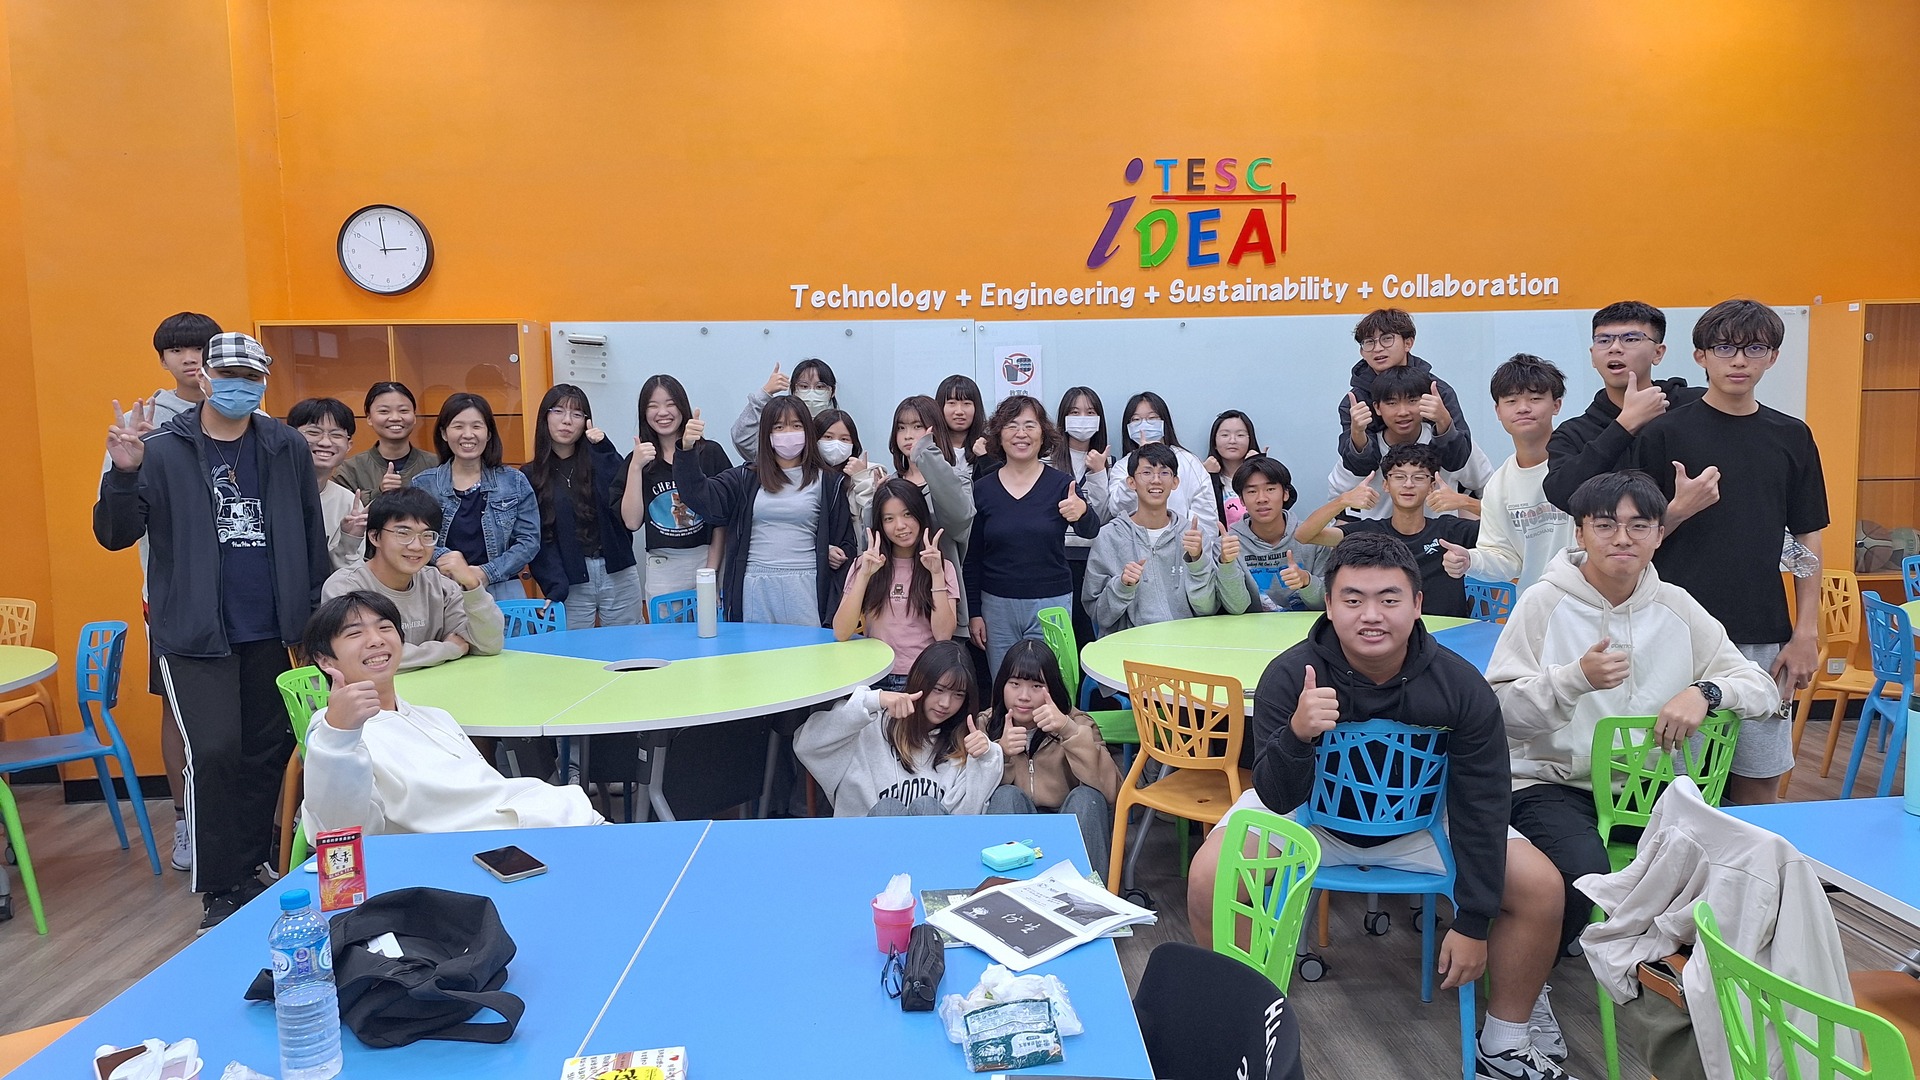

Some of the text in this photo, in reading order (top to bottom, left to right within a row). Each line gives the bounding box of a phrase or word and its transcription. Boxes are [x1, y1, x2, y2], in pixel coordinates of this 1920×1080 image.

[1154, 158, 1273, 192] TESC
[790, 283, 946, 311] Technology
[980, 281, 1136, 310] Engineering
[1169, 276, 1349, 304] Sustainability
[1382, 272, 1559, 299] Collaboration
